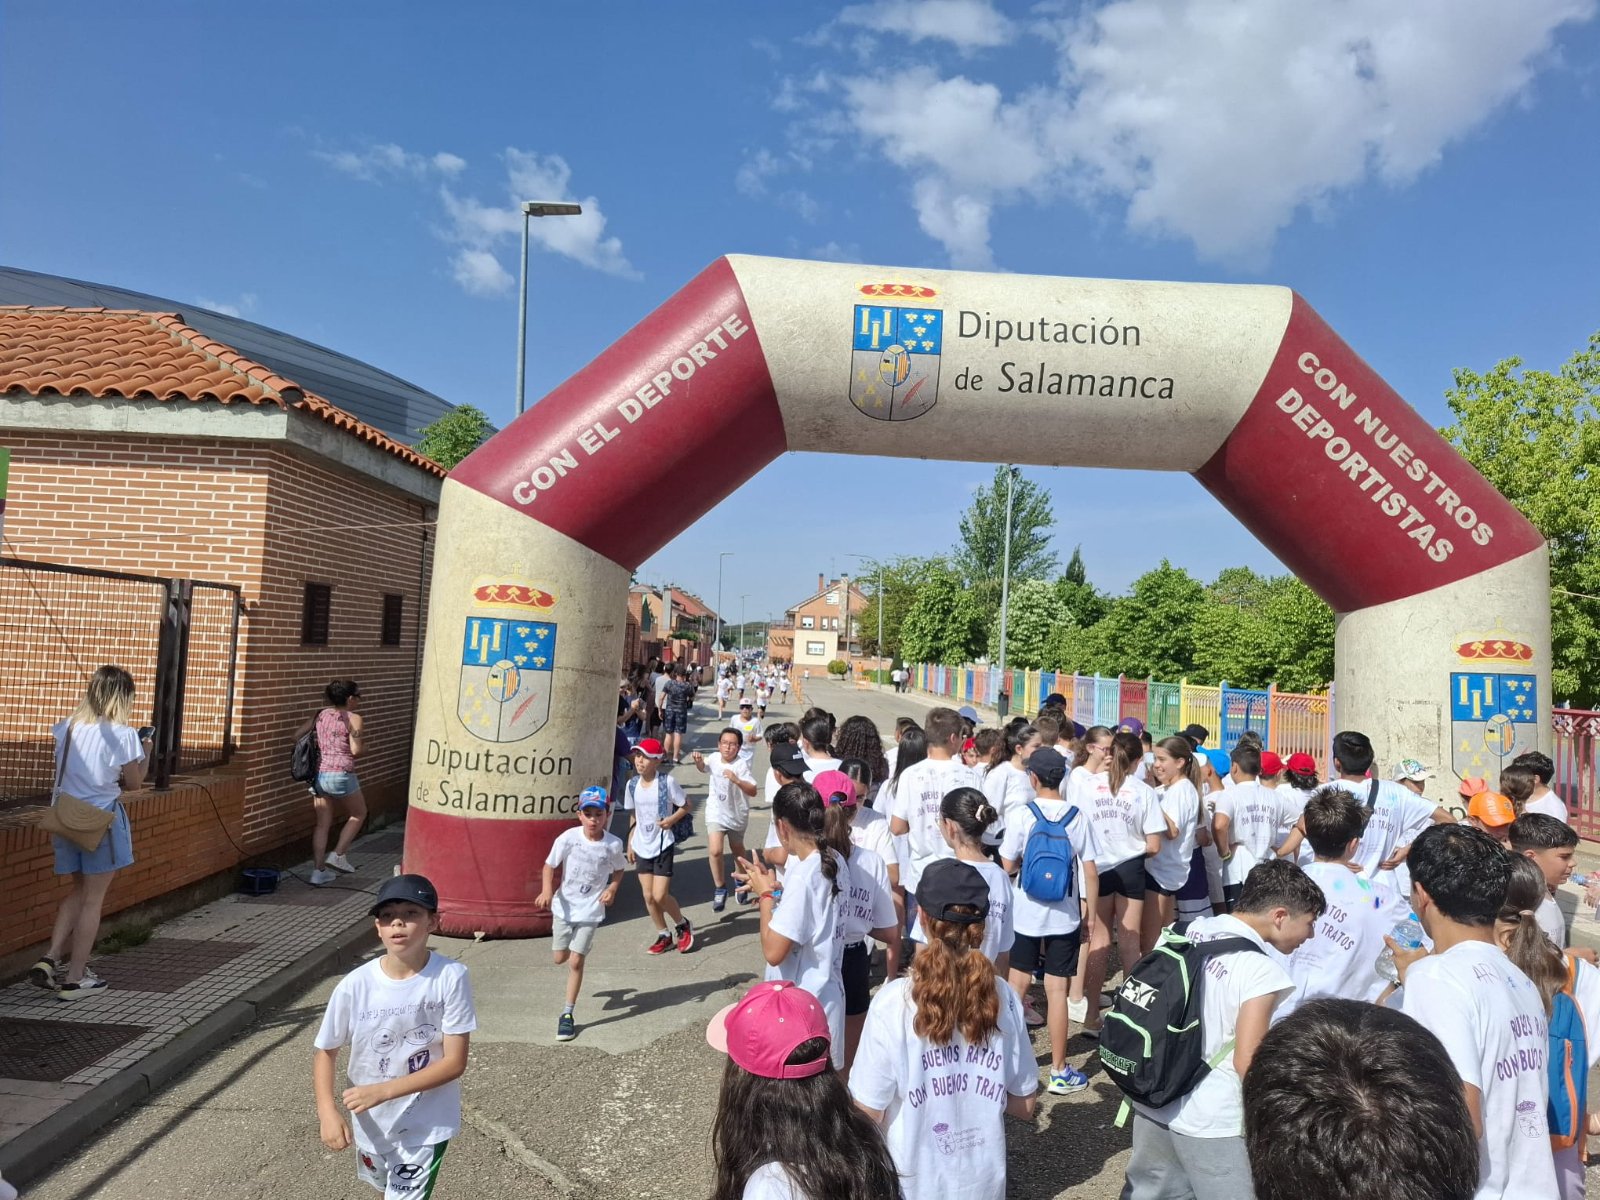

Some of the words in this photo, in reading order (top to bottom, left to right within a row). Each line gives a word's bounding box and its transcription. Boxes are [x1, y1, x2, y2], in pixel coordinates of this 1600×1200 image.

[957, 310, 1141, 347] Diputación
[954, 366, 984, 391] de
[997, 361, 1175, 400] Salamanca
[512, 447, 579, 505] CON
[576, 420, 620, 456] EL
[617, 312, 749, 425] DEPORTE
[1297, 351, 1357, 410] CON
[1354, 407, 1494, 546] NUESTROS
[1275, 387, 1454, 563] DEPORTISTAS
[426, 738, 573, 775] Diputación
[416, 780, 430, 803] de
[437, 780, 580, 814] Salamanca
[1321, 922, 1355, 951] TRATOS
[921, 1044, 960, 1071] BUENOS
[965, 1044, 1002, 1071] RATOS
[1496, 1054, 1519, 1081] CON
[908, 1082, 928, 1109] CON
[931, 1073, 968, 1097] BUENOS
[975, 1075, 1007, 1106] TRATO
